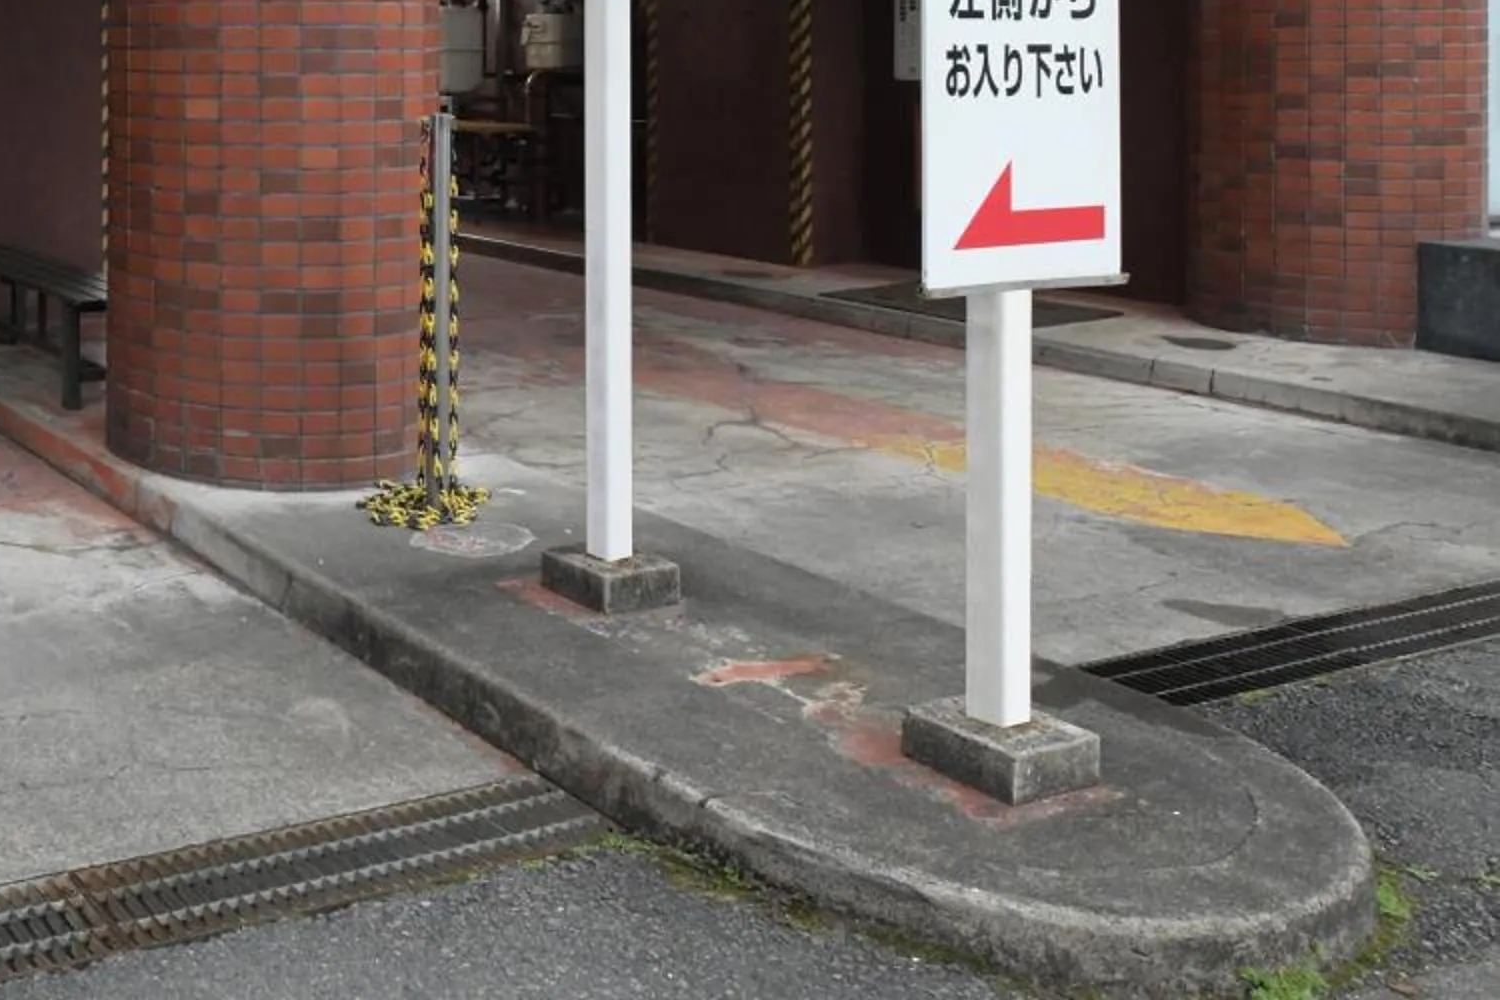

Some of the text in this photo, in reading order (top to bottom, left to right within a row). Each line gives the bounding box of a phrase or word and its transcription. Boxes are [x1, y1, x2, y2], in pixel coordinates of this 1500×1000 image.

[946, 44, 1102, 97] お入り下さい
